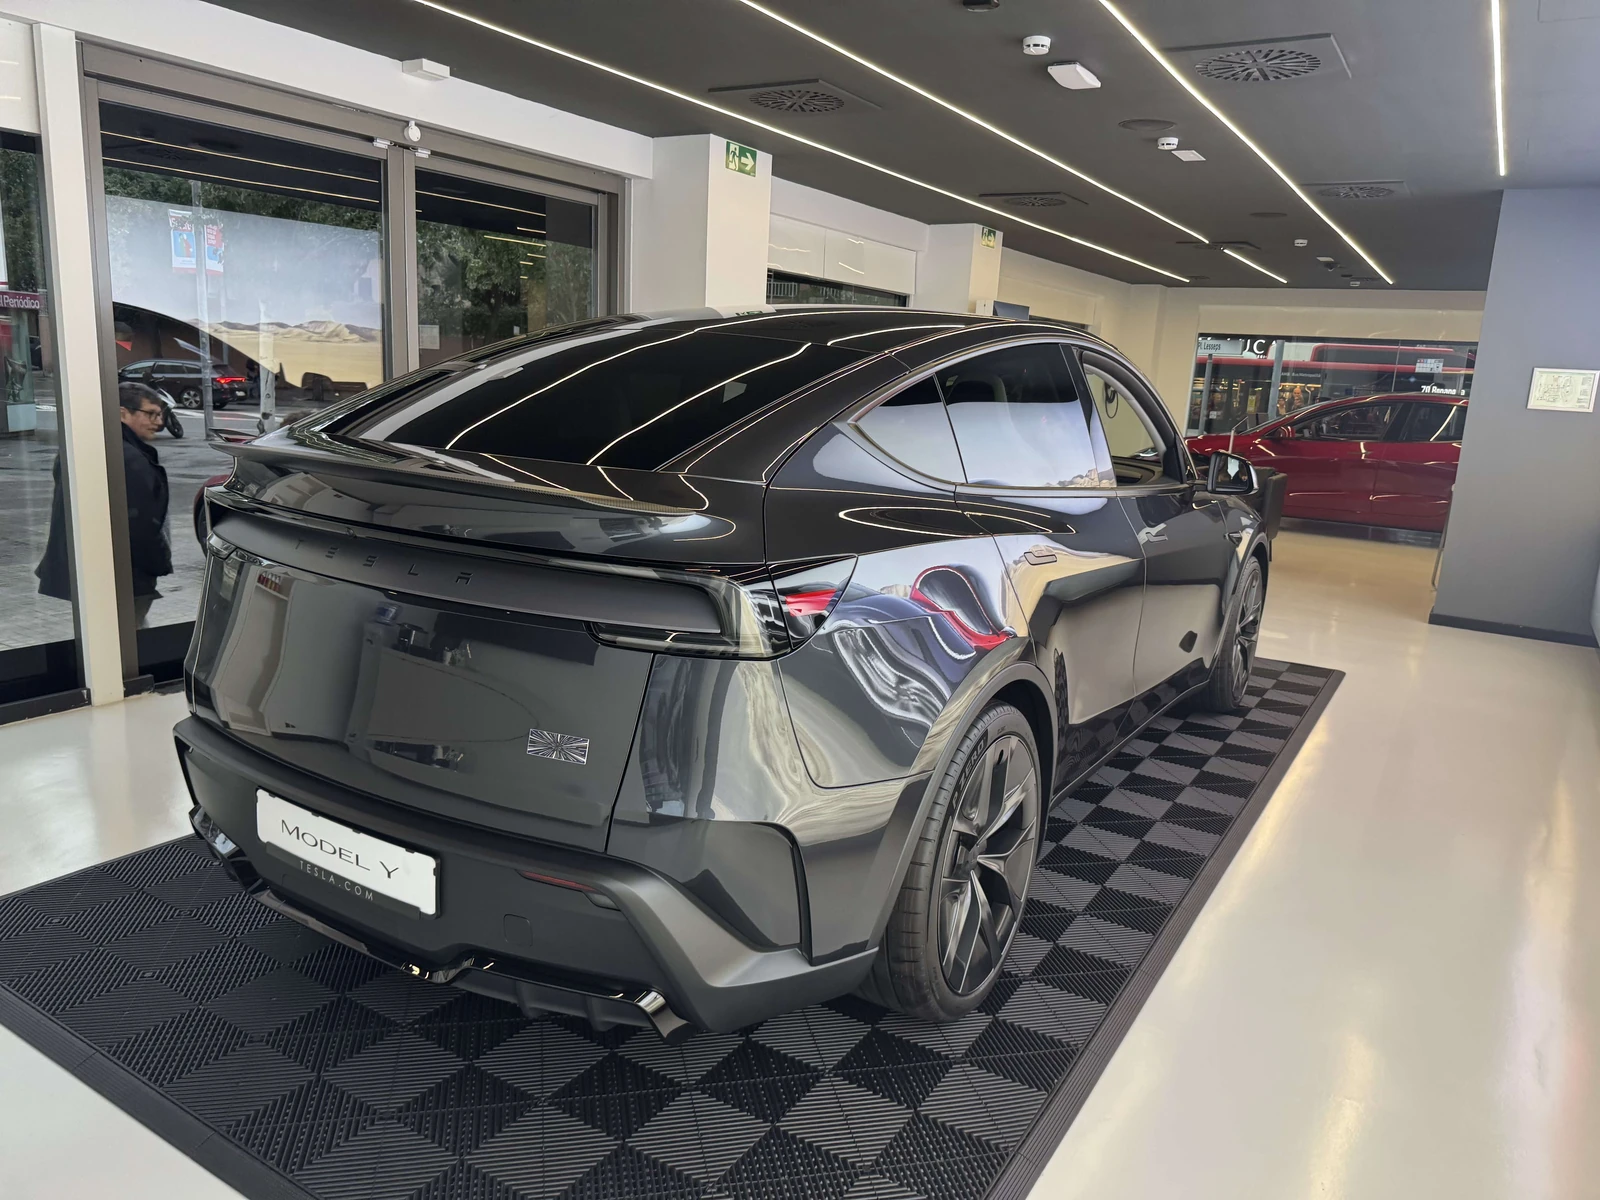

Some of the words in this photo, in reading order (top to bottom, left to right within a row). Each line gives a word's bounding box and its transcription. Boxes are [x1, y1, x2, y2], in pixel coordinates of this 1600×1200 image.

[1203, 341, 1221, 353] Lesseps
[295, 539, 473, 585] TESLA
[959, 739, 986, 791] ZERO
[281, 819, 371, 872] MODEL
[379, 860, 399, 879] Y
[299, 860, 375, 901] TESLA.COM
